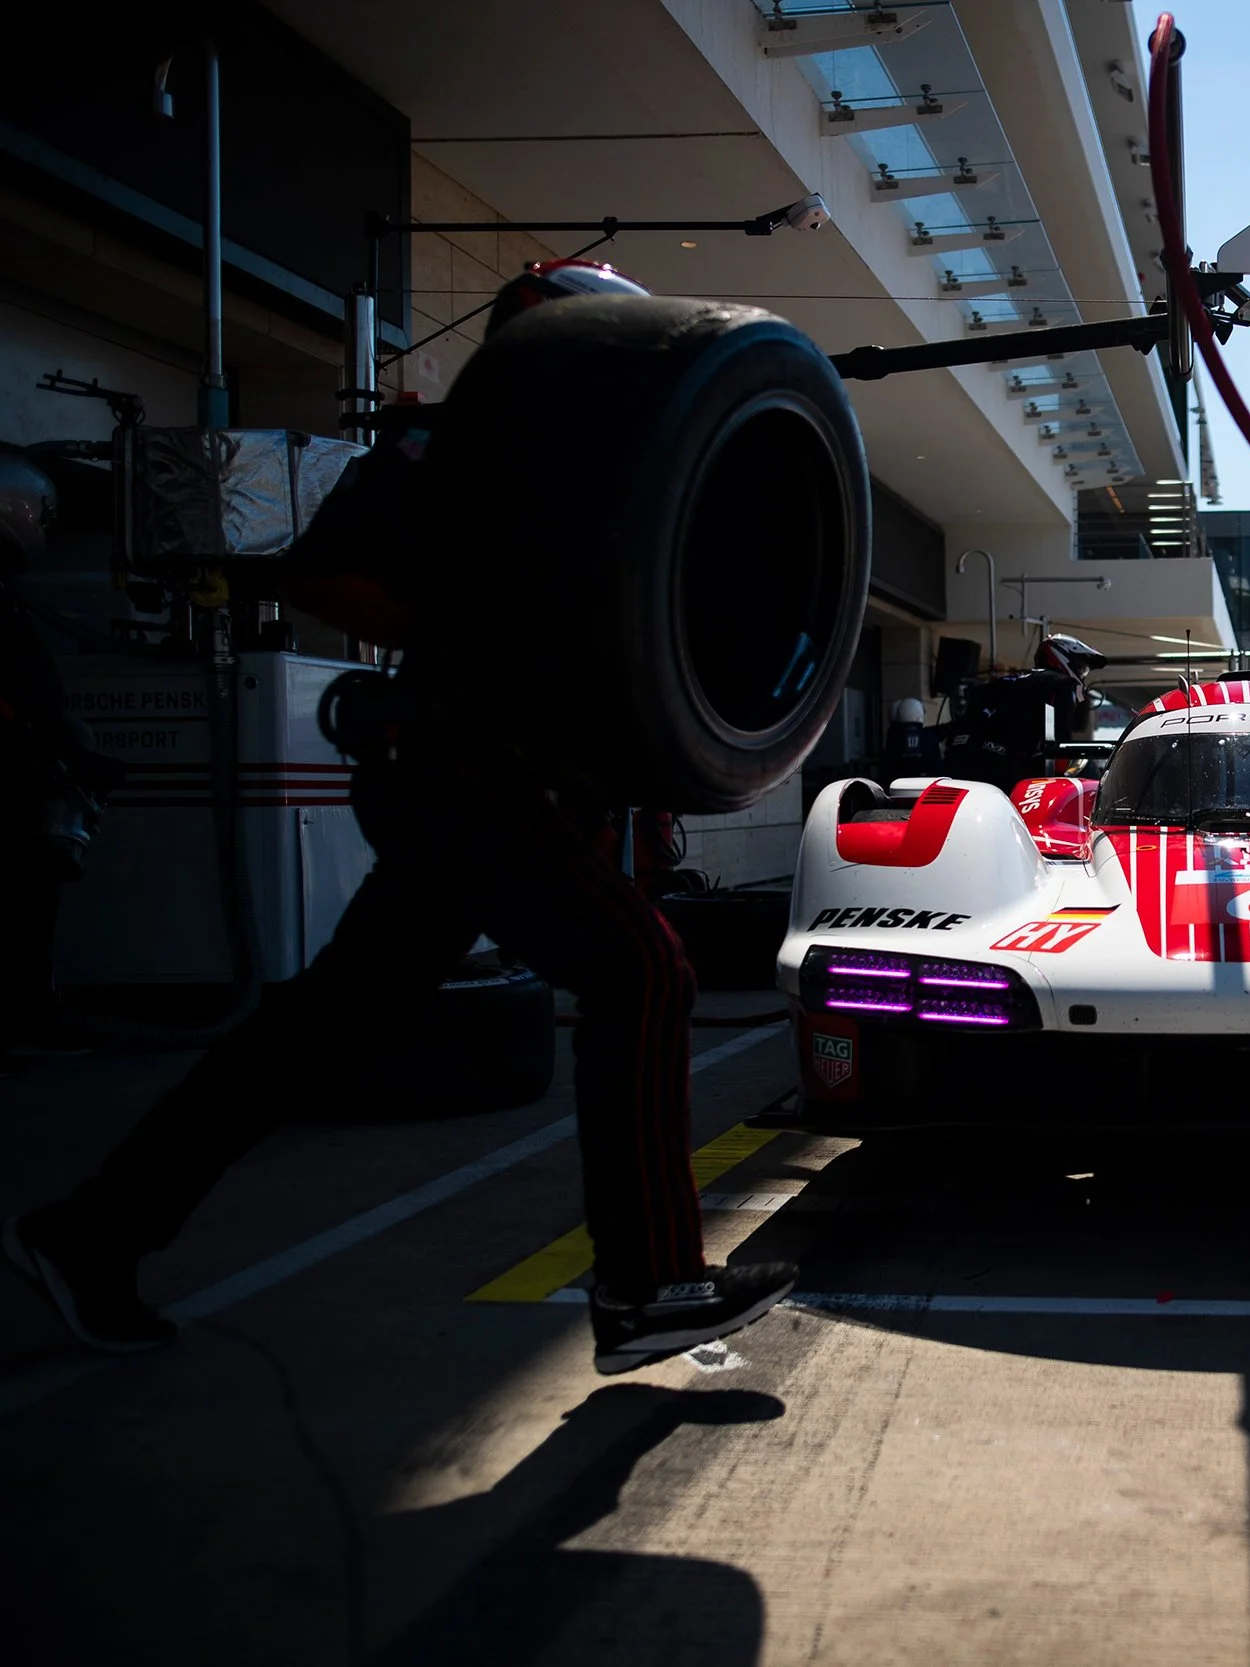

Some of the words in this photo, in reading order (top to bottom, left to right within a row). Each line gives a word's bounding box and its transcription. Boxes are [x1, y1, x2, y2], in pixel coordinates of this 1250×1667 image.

[62, 692, 136, 710] ORSCHE
[141, 691, 206, 709] PENSK
[806, 908, 973, 932] PENSKE
[997, 923, 1088, 950] HY
[815, 1037, 850, 1059] TAG
[814, 1057, 850, 1084] HEUER
